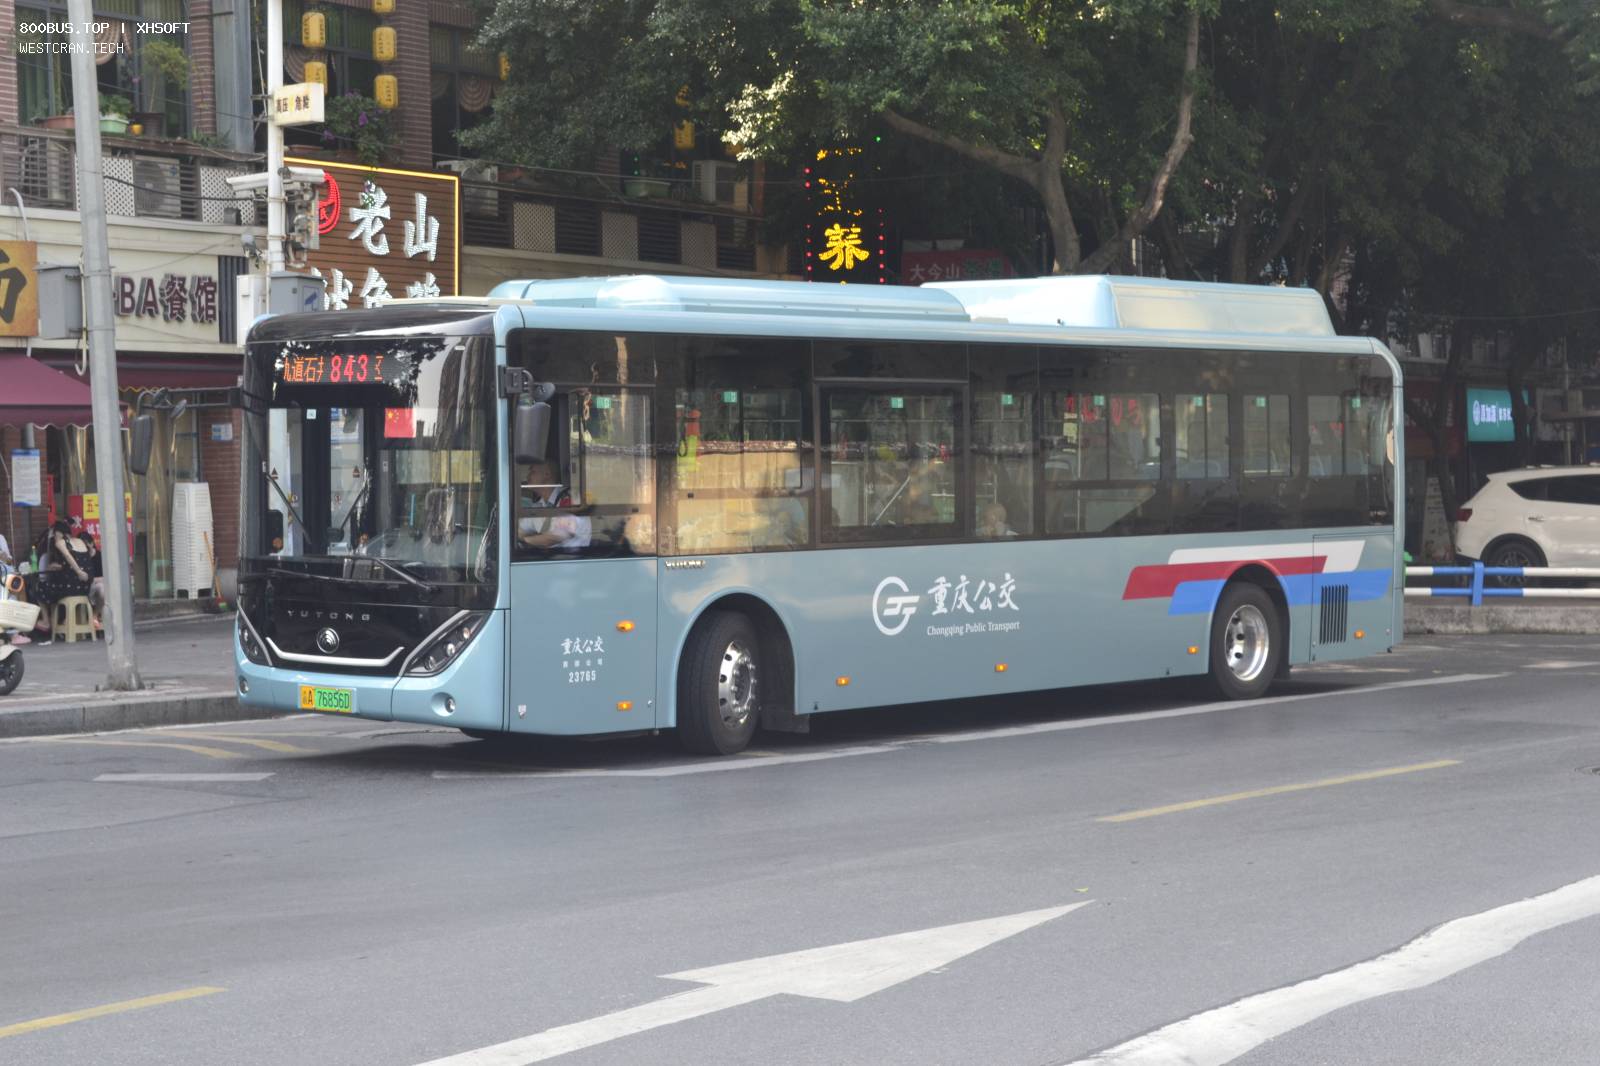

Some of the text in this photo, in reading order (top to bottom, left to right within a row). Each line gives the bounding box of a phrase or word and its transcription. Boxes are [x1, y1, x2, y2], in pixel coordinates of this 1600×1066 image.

[330, 354, 369, 383] 843
[927, 572, 1020, 616] 重庆公交
[287, 610, 371, 621] YUTONG
[927, 621, 1021, 637] Chongqing Public Transport
[560, 636, 605, 655] 重庆公交
[568, 670, 597, 683] 23765
